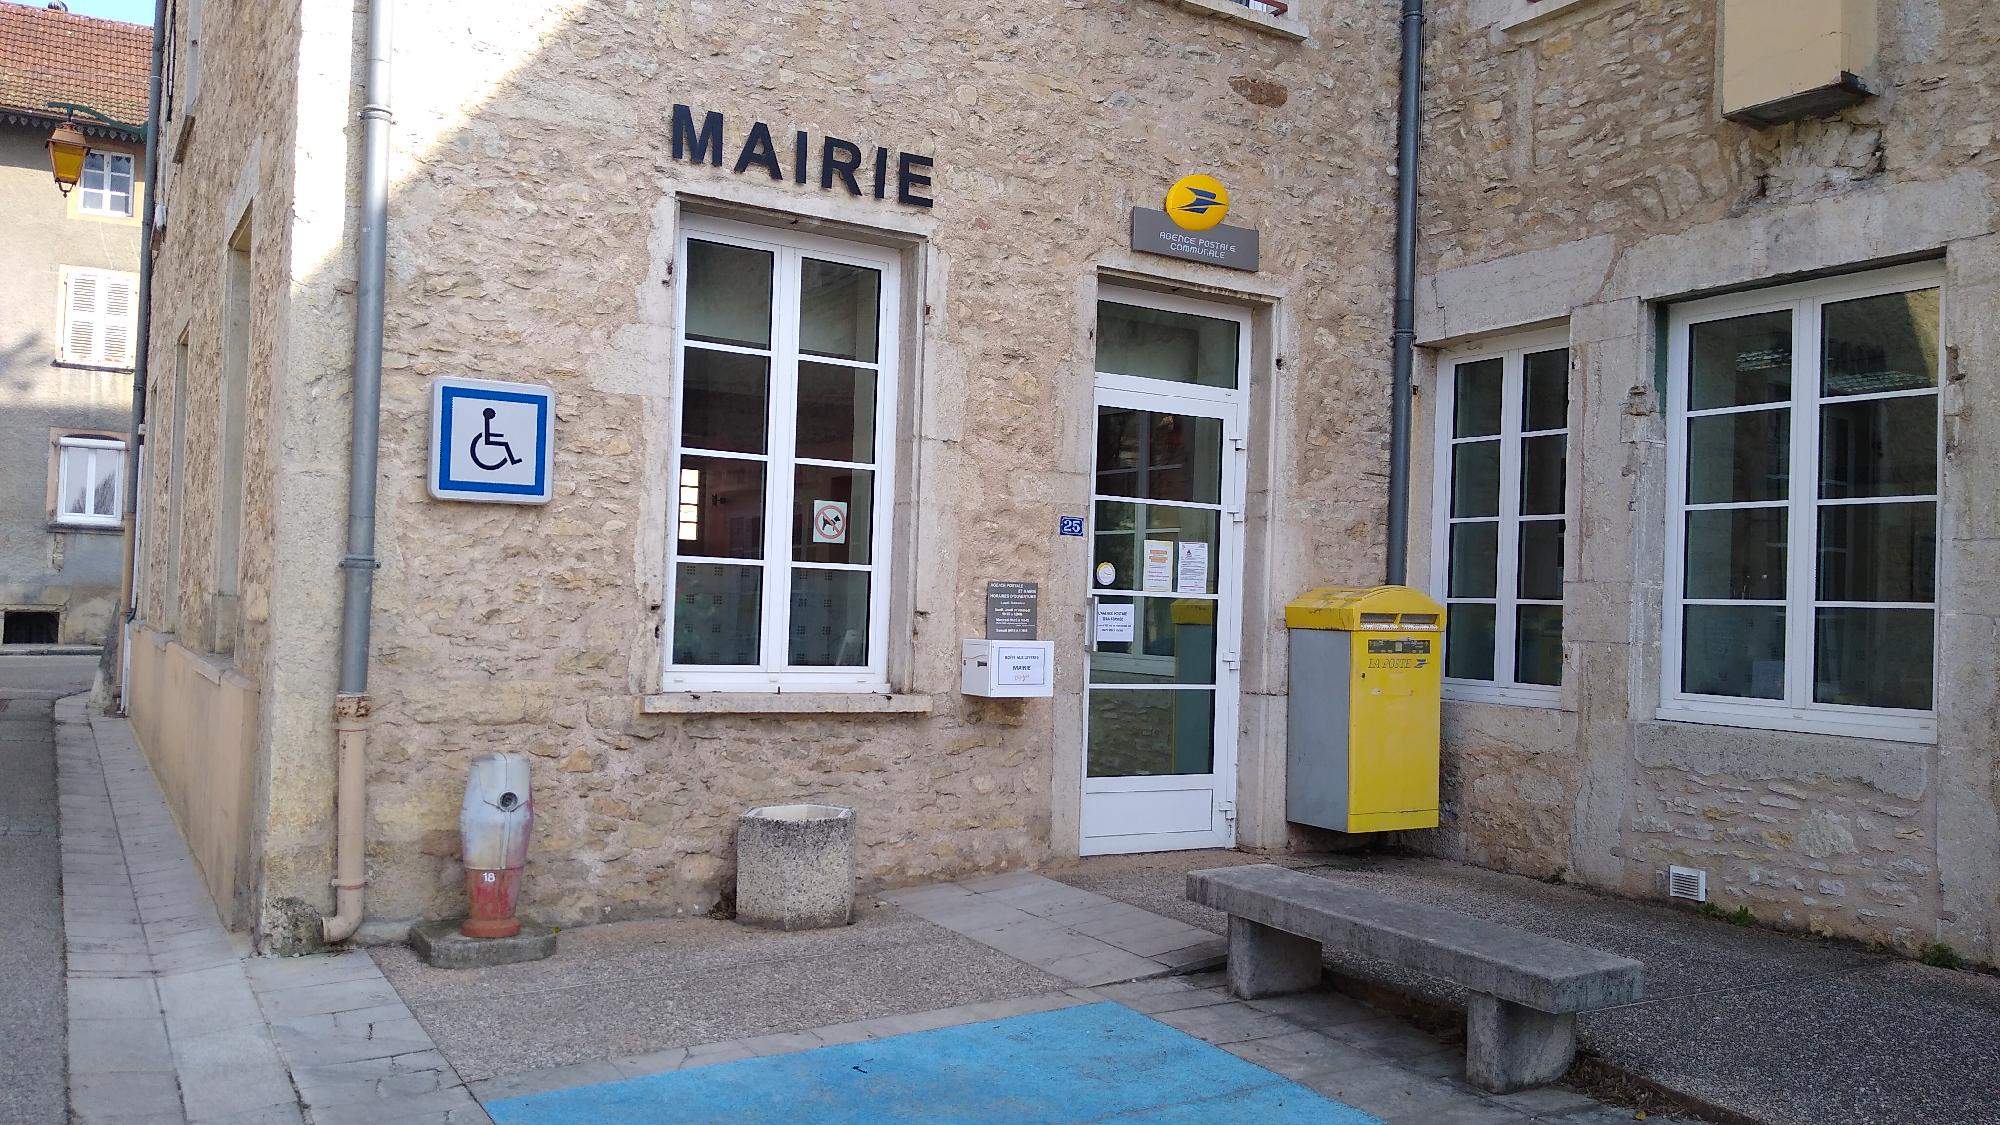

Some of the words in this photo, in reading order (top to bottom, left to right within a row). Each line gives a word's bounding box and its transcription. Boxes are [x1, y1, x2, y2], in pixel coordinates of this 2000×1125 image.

[672, 103, 933, 208] MAIRIE
[1159, 231, 1197, 245] AGENCE
[1198, 239, 1237, 252] POSTALE
[1170, 243, 1226, 258] COMMUNALE
[1064, 519, 1081, 532] 25
[1368, 658, 1381, 669] LA
[1382, 658, 1412, 669] POSTE
[482, 872, 496, 882] 18
